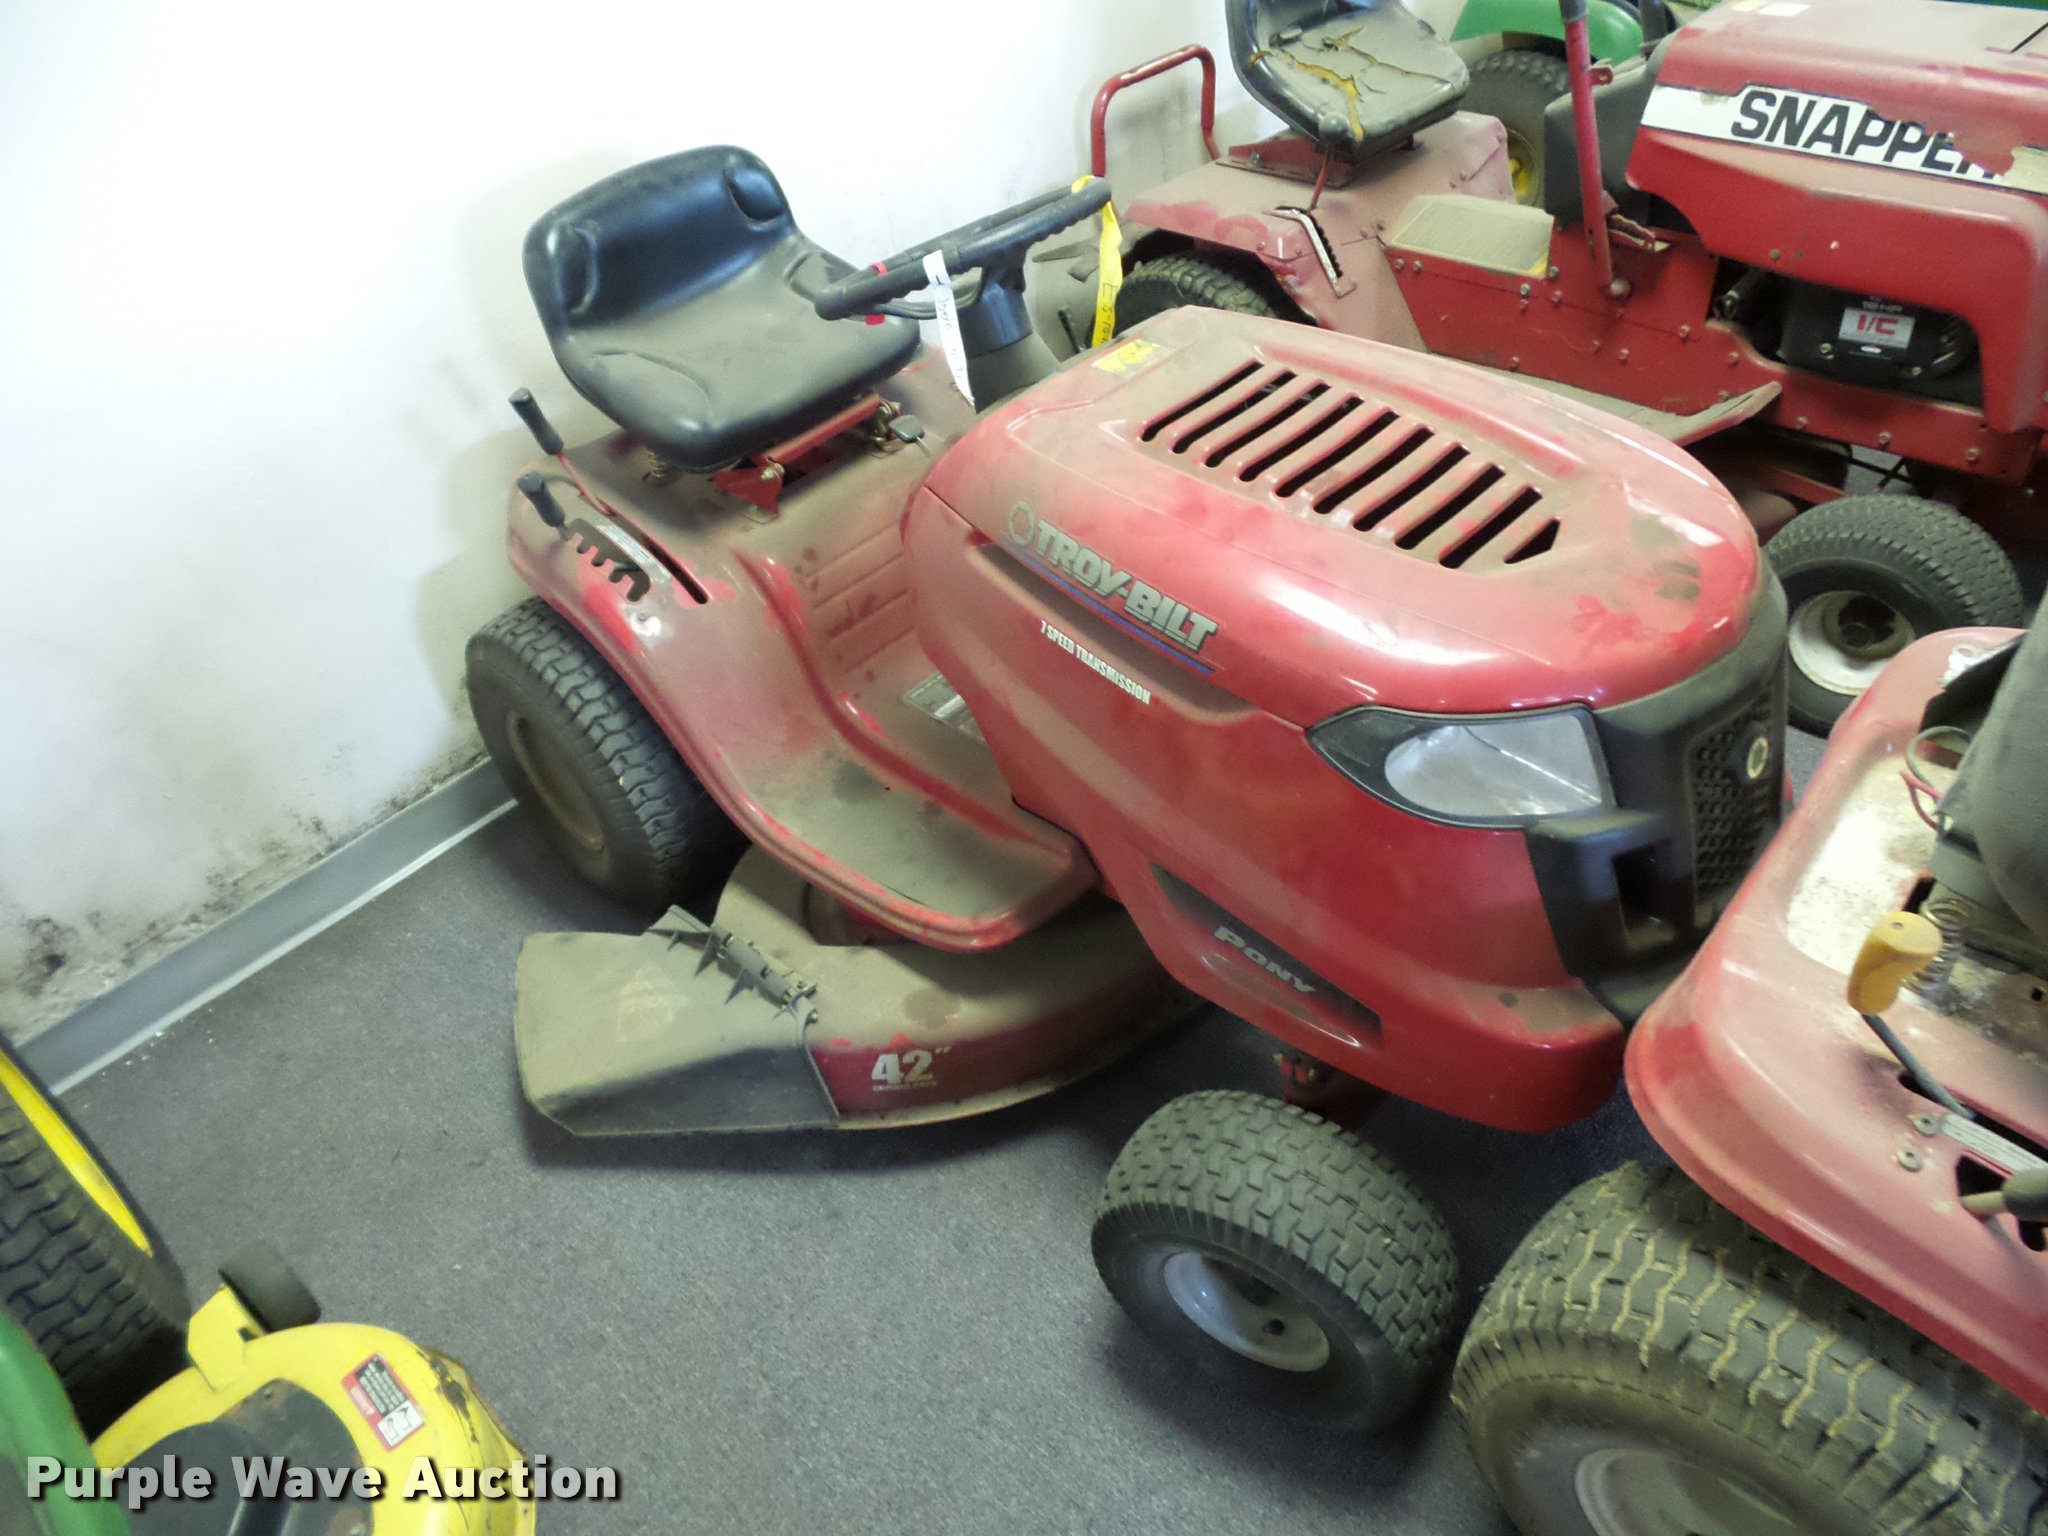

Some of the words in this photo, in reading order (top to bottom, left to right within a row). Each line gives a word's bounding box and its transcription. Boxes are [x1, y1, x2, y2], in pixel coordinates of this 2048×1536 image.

[1731, 89, 1996, 179] SNAPPE
[1037, 518, 1218, 652] TROY-BILT
[1047, 624, 1075, 654] SPEED
[1076, 643, 1151, 705] TRANSMISSION
[1214, 926, 1317, 992] PONY
